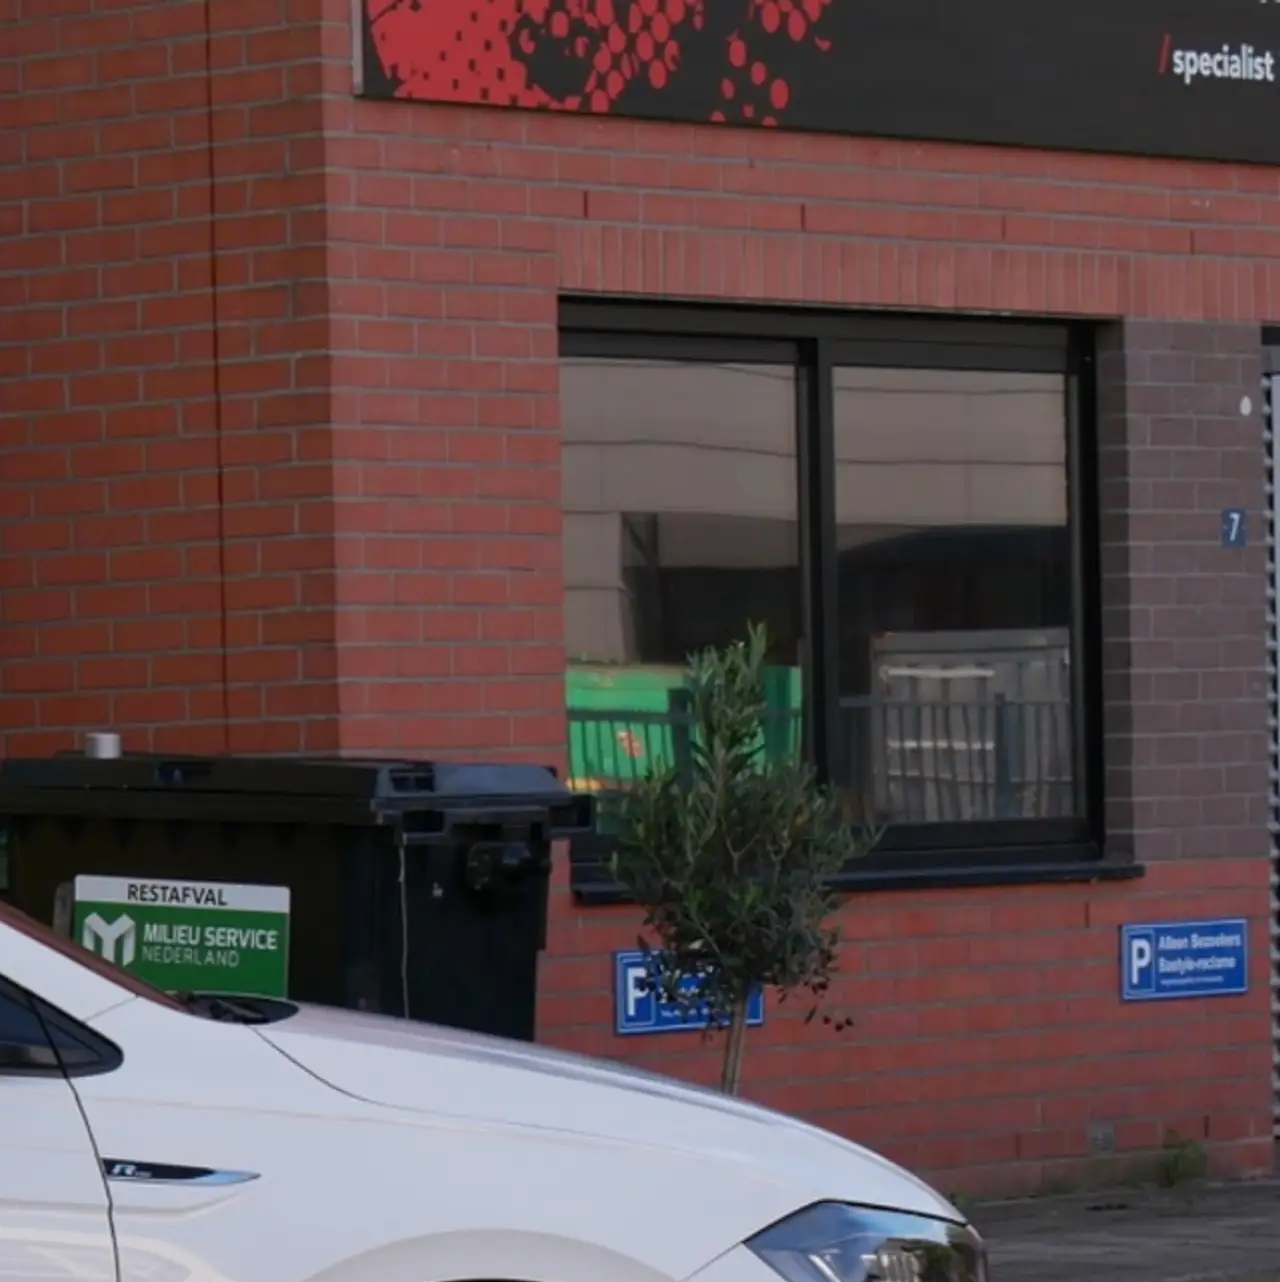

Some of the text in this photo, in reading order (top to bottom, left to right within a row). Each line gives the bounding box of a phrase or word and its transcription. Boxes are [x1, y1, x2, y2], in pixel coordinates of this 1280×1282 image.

[1228, 511, 1242, 542] 7
[126, 883, 229, 907] RESTAFVAL
[143, 921, 279, 950] MILIEU SERVICE
[141, 945, 240, 968] NEDERLAND
[1131, 937, 1151, 985] P
